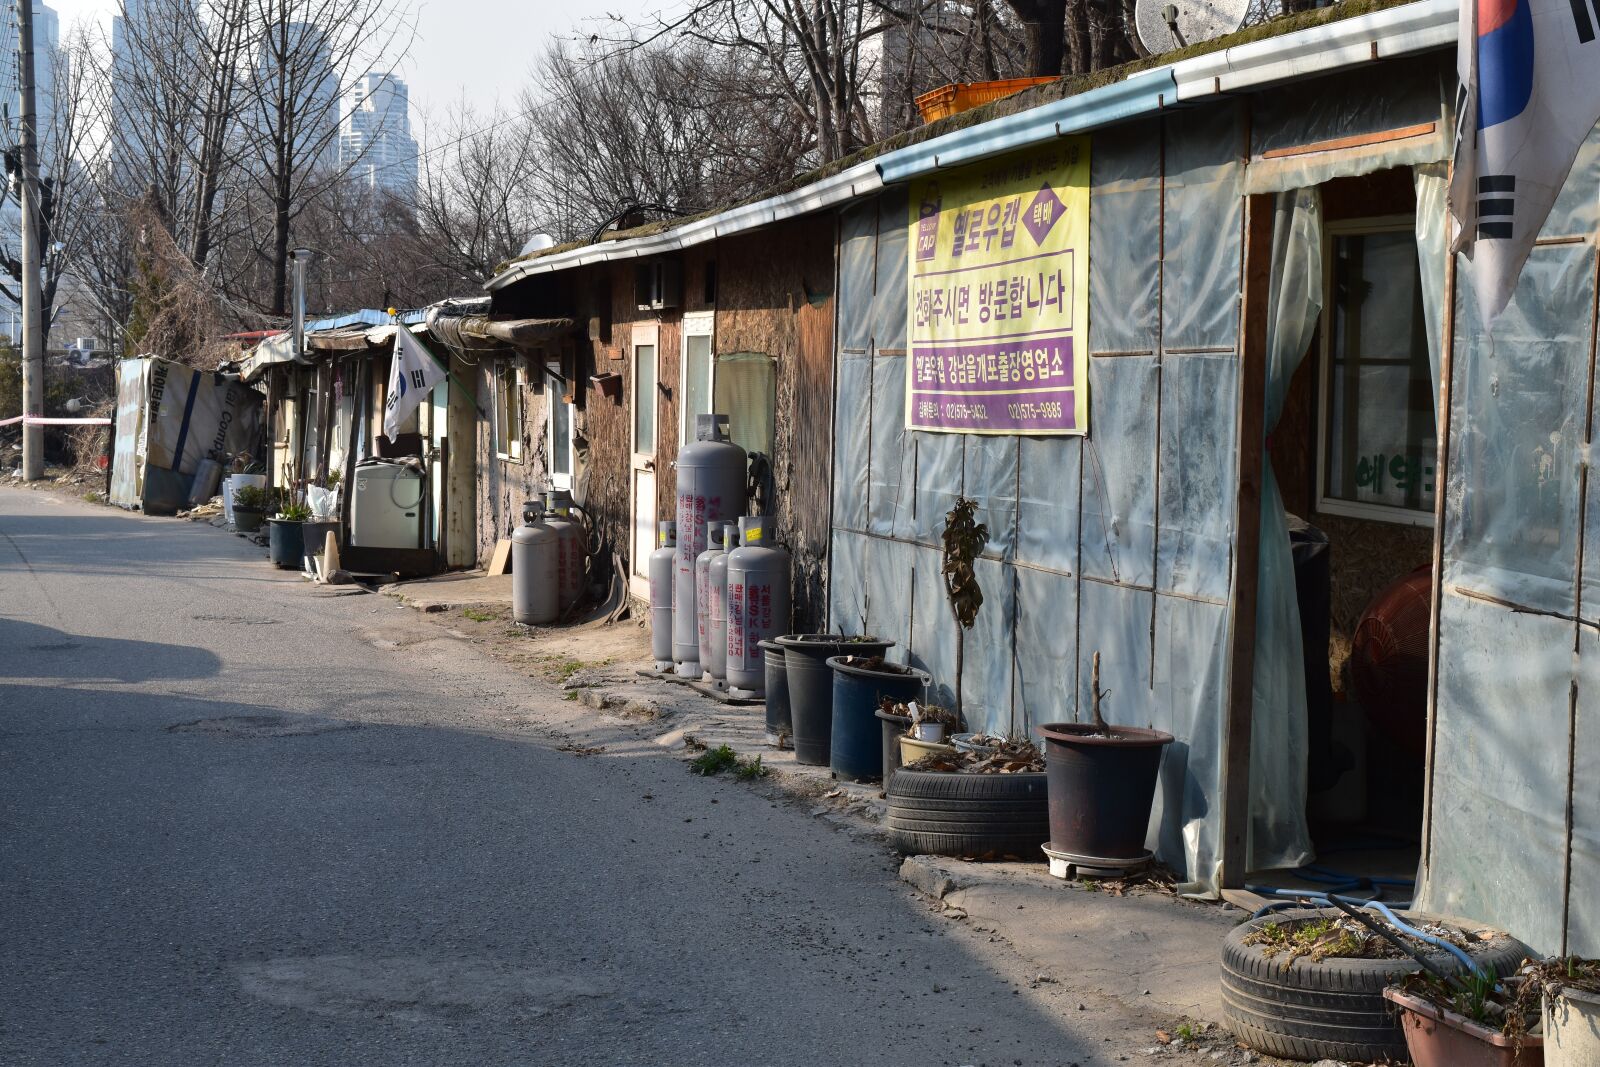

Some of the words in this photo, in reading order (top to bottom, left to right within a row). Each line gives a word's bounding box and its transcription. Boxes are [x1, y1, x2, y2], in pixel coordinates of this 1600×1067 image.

[952, 197, 1021, 257] 옐로우캡
[1033, 200, 1053, 227] 택배
[918, 234, 935, 251] CAP
[915, 284, 970, 327] 전화주시면
[979, 269, 1066, 323] 방문합니다
[916, 355, 945, 383] 옐로우캡
[1008, 401, 1062, 421] 02)575-9885
